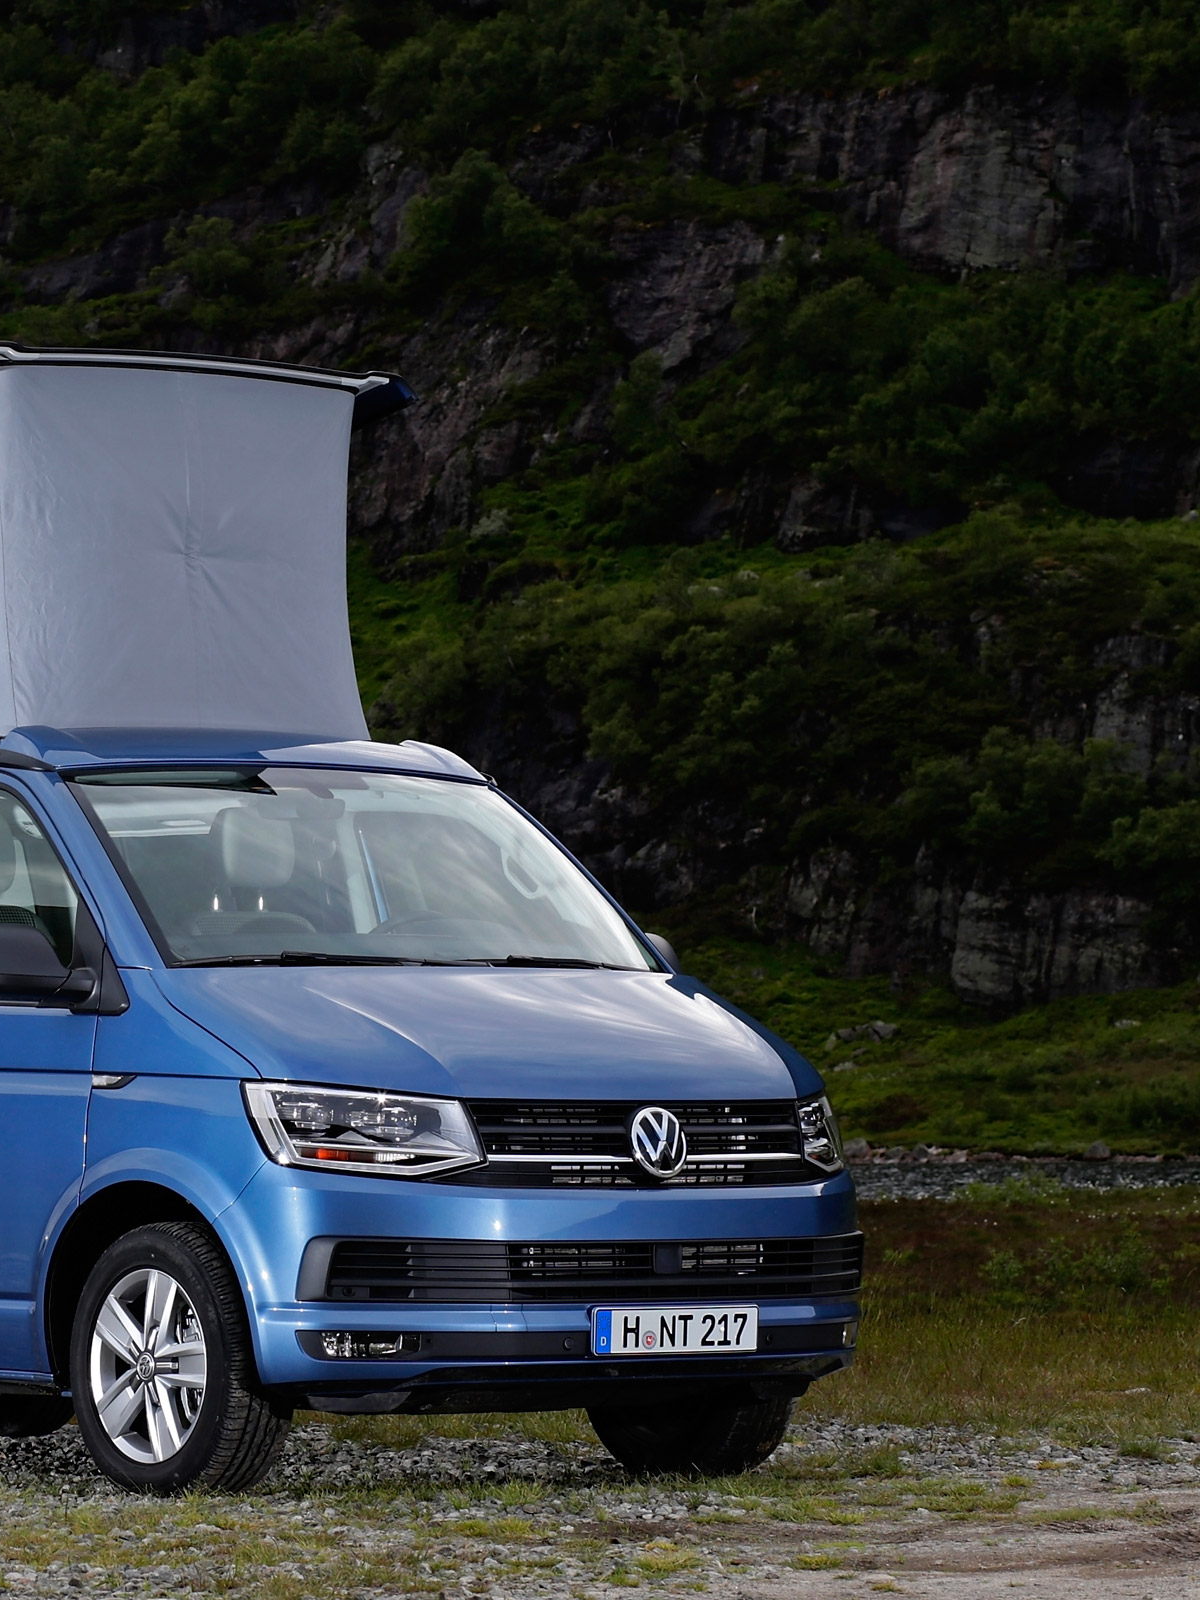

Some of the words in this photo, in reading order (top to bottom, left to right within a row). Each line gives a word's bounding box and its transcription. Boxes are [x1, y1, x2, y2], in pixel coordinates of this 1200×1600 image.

[632, 1108, 682, 1173] VW
[600, 1337, 607, 1346] D
[623, 1316, 640, 1348] H
[660, 1314, 693, 1347] NT
[701, 1313, 748, 1346] 217
